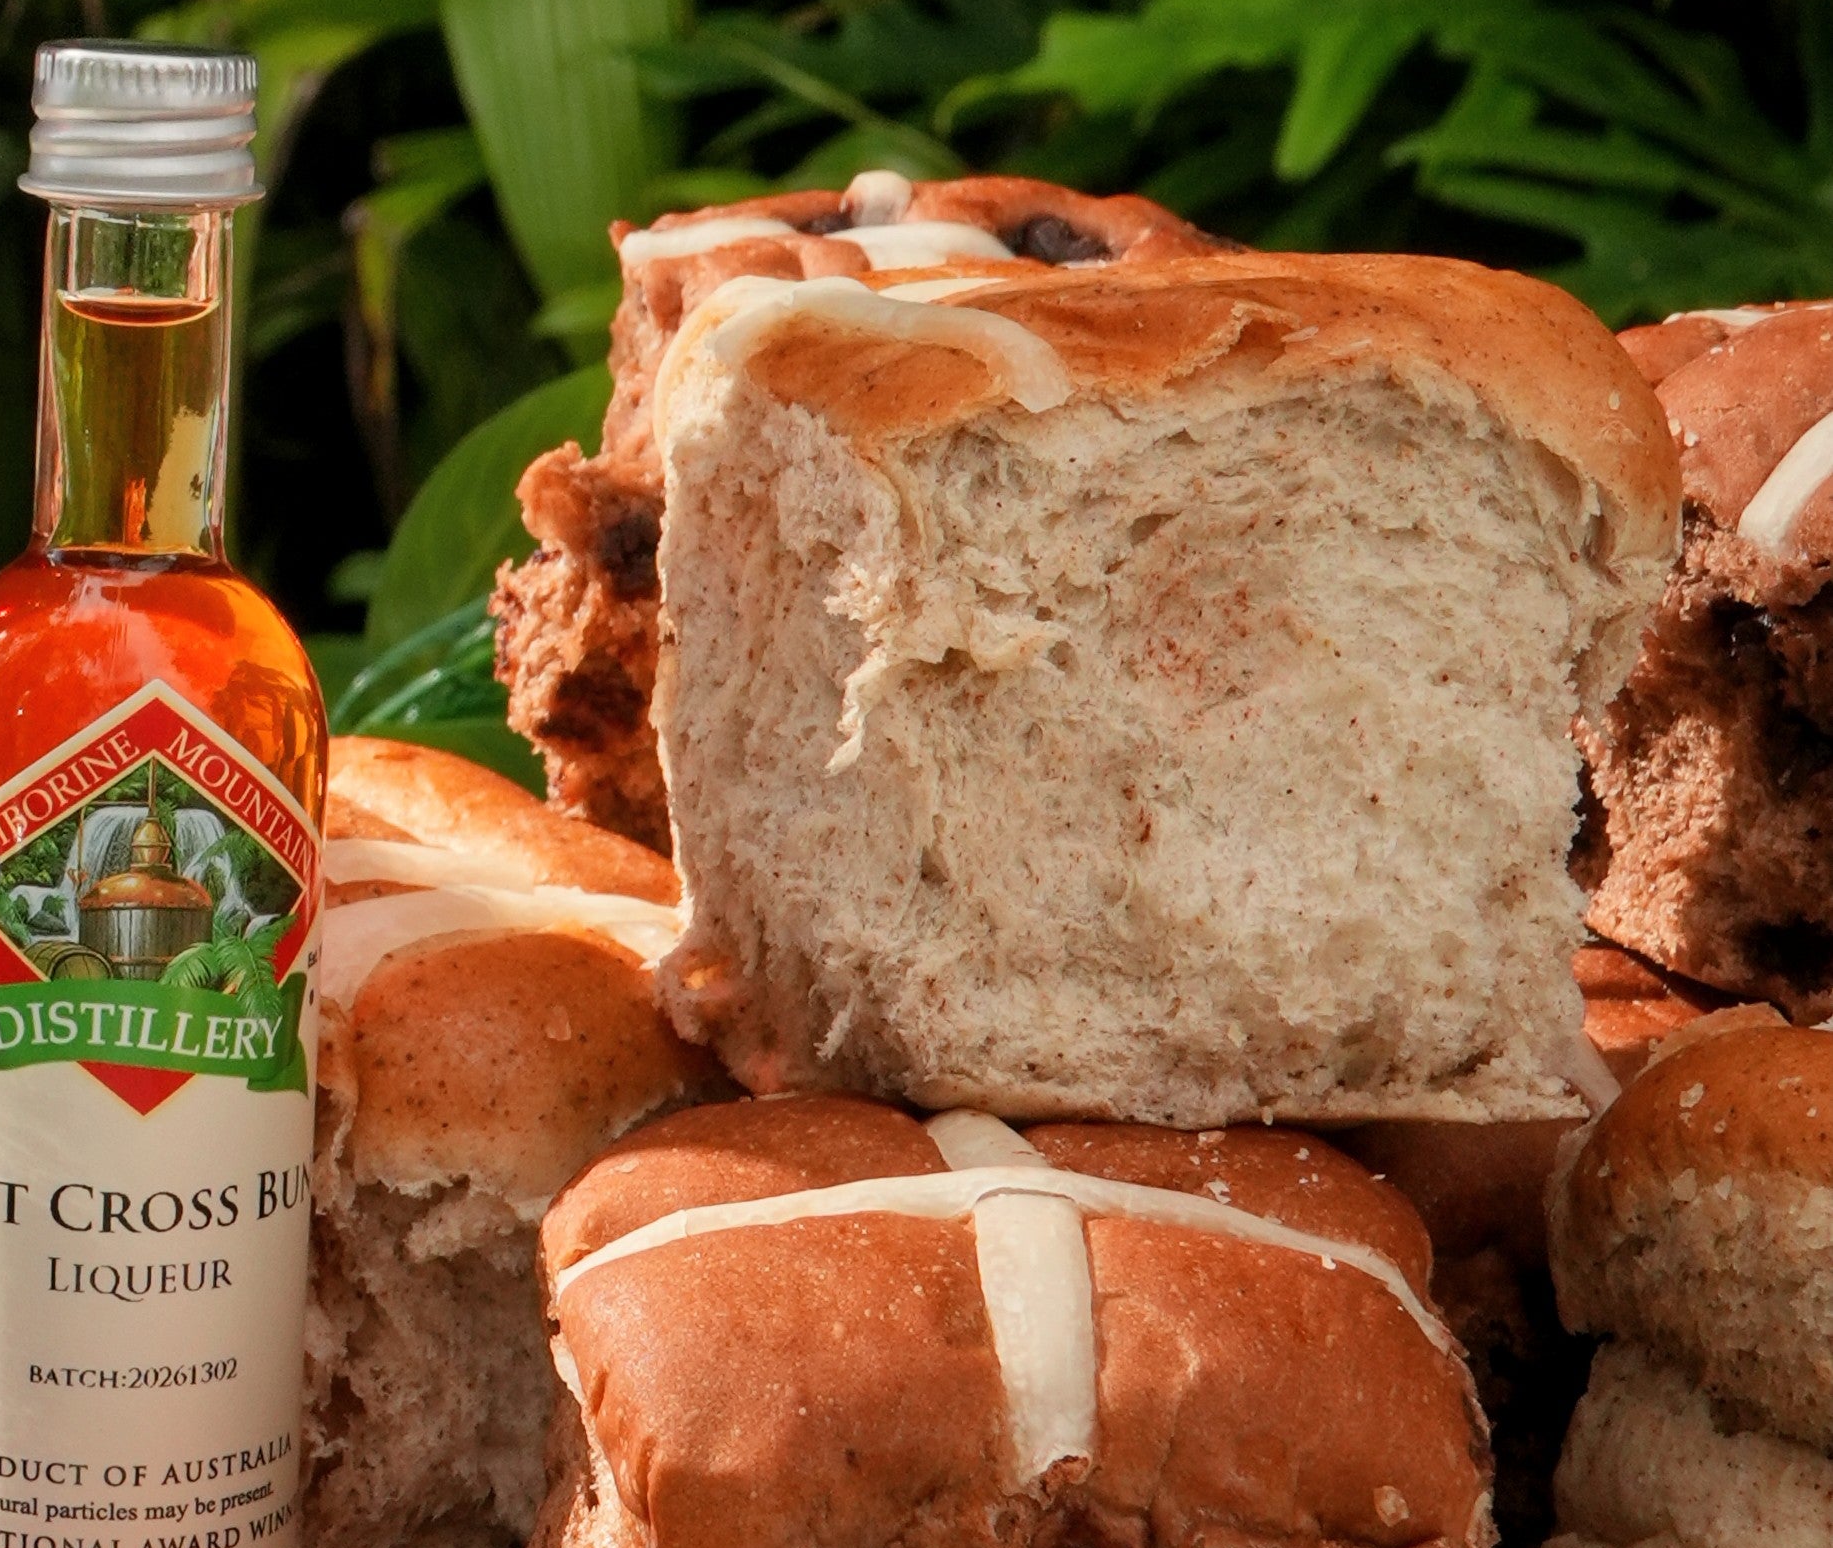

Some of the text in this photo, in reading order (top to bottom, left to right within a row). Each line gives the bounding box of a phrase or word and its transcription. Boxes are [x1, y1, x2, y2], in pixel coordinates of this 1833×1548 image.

[165, 726, 314, 879] MOUNTAIN
[29, 1357, 239, 1390] BATCH:20261302
[103, 1465, 148, 1488] OF
[161, 1431, 293, 1486] AUSTRALIA
[44, 1501, 138, 1523] particles
[144, 1504, 188, 1523] may
[194, 1497, 217, 1516] be
